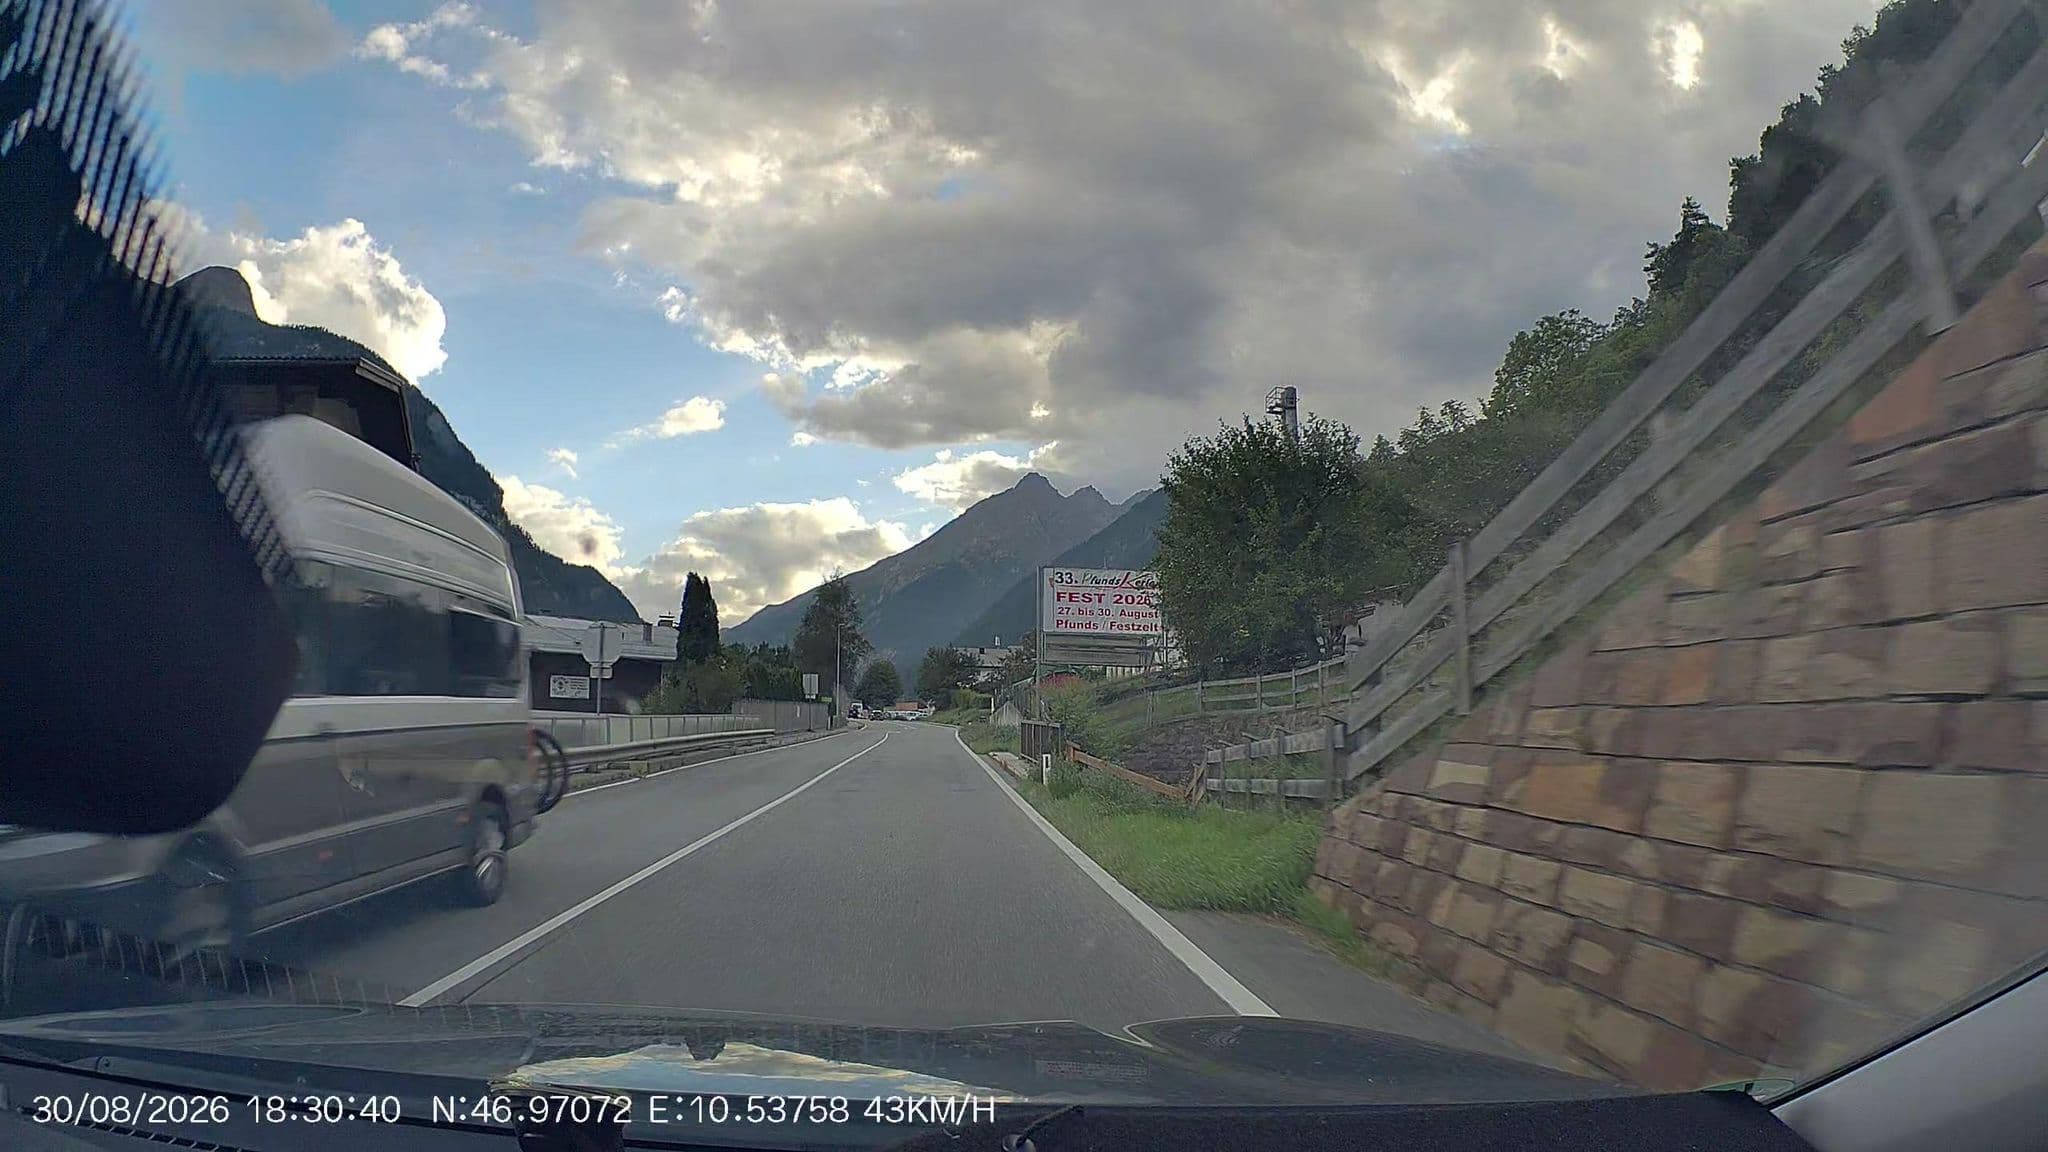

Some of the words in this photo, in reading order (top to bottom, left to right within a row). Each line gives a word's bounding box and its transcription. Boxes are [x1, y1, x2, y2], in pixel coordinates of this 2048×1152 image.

[1055, 571, 1078, 584] 33.
[1056, 591, 1106, 604] FEST
[1058, 606, 1075, 616] 27.
[1078, 607, 1094, 616] bis
[1098, 608, 1114, 617] 30.
[1119, 608, 1159, 620] August
[1056, 619, 1099, 630] Pfunds
[1109, 621, 1159, 632] Festzelt
